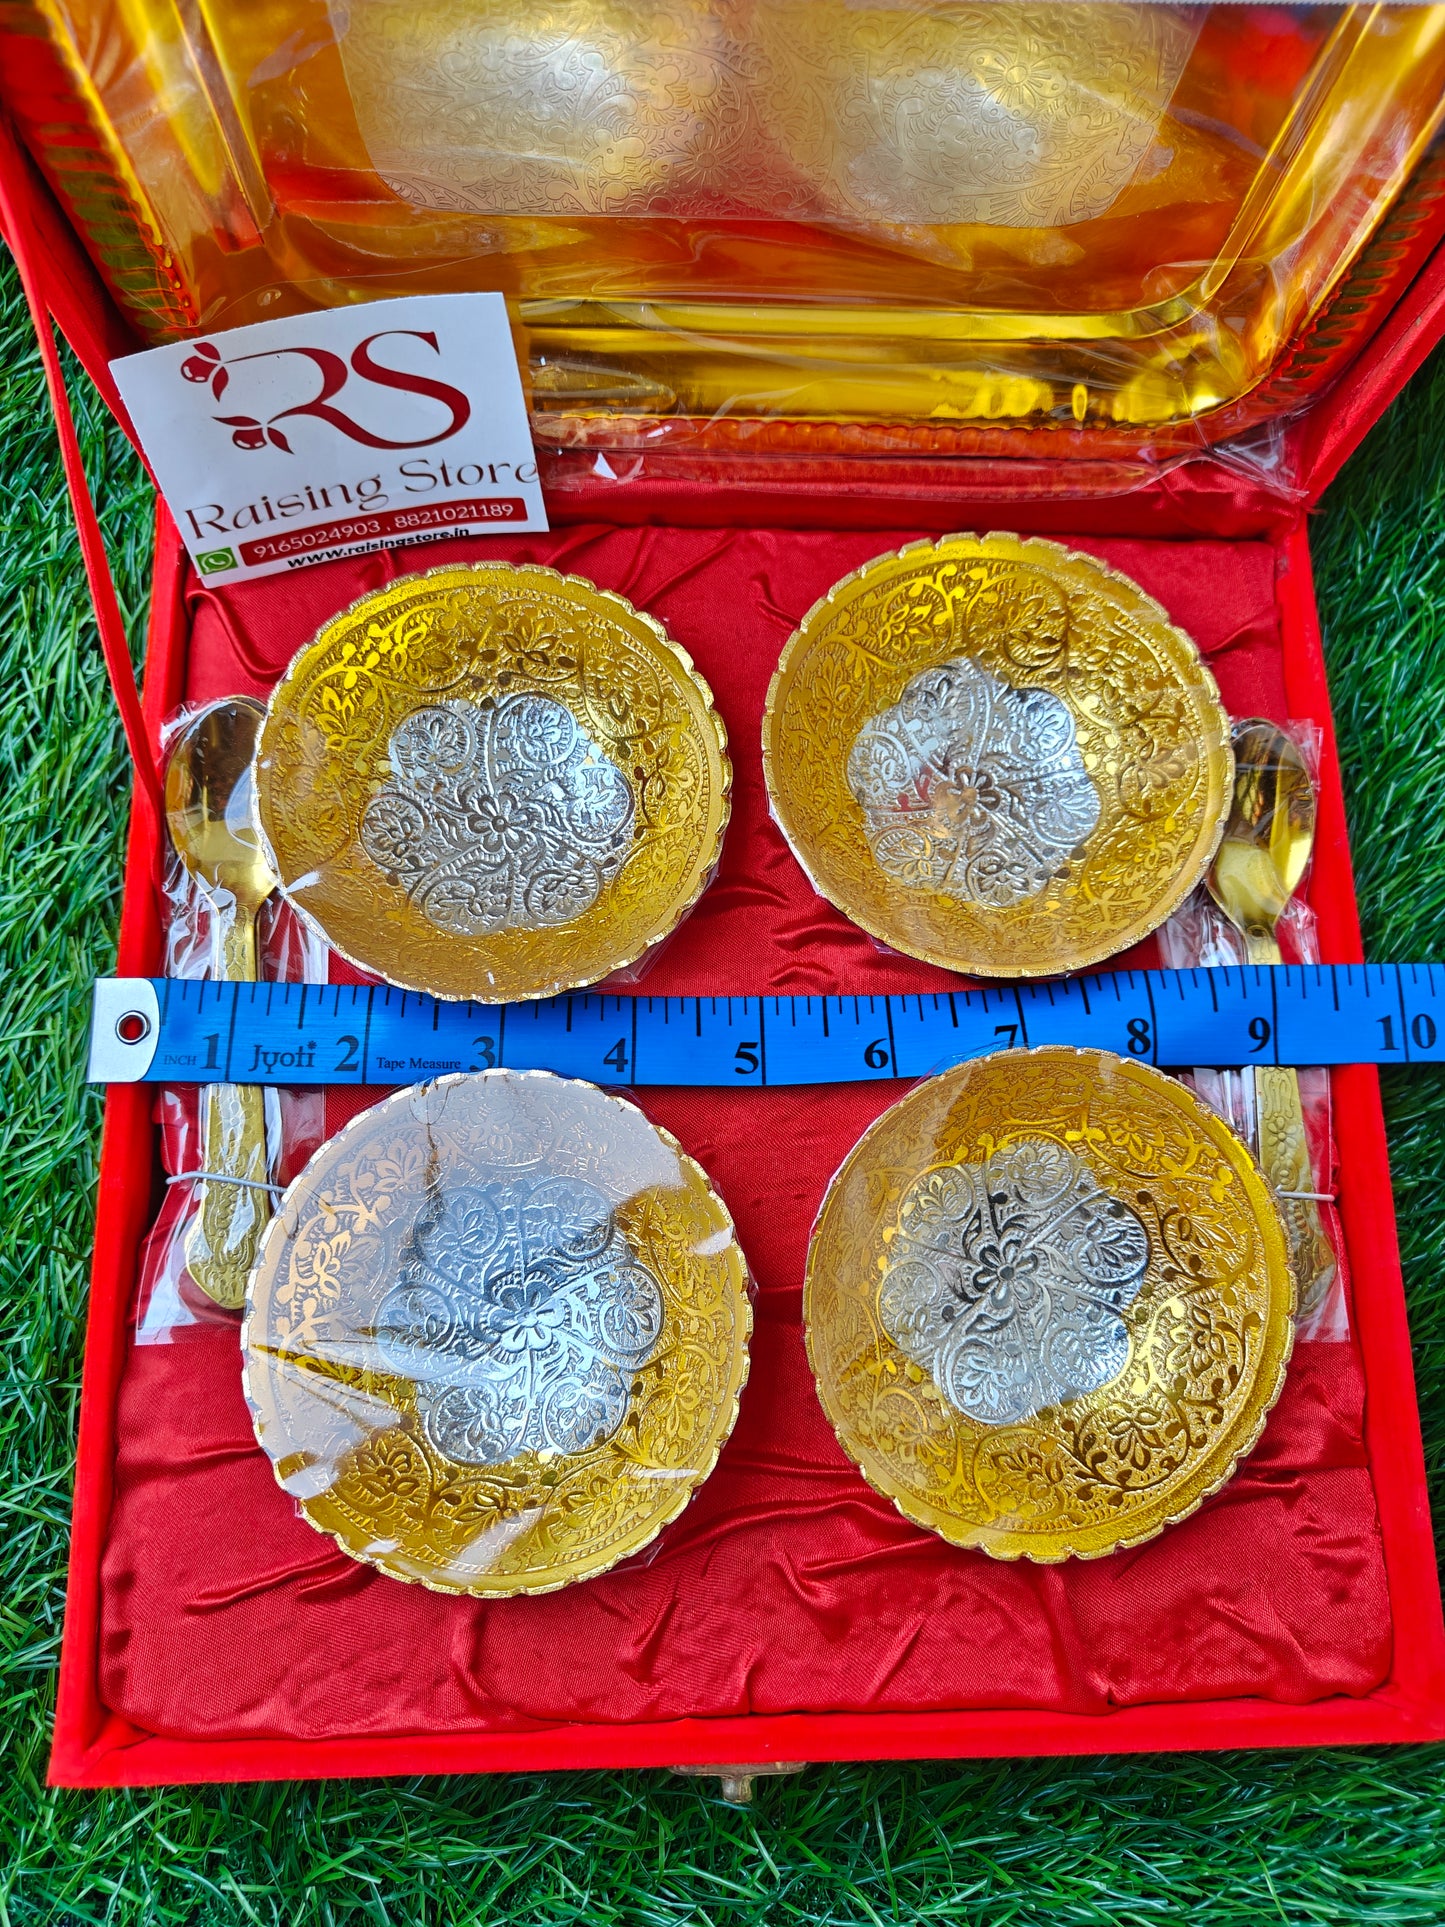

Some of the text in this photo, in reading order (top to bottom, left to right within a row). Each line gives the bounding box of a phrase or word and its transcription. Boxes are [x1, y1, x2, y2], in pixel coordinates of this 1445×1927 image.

[222, 330, 471, 450] RS
[185, 457, 539, 539] Raising Store
[253, 519, 381, 558] 9165024903
[394, 503, 514, 529] 8821021189
[287, 527, 469, 568] www.raisingstore.in
[994, 1024, 1018, 1049] 7
[1126, 1018, 1151, 1055] 8
[1248, 1016, 1271, 1053] 9
[1376, 1013, 1437, 1052] 10
[164, 1033, 222, 1070] INCH 1
[248, 1040, 317, 1074] Jyoti
[334, 1034, 360, 1072] 2
[376, 1057, 461, 1071] Tape Measure
[469, 1036, 496, 1072] 3
[603, 1038, 629, 1072] 4
[734, 1041, 760, 1074] 5
[864, 1038, 889, 1069] 6
